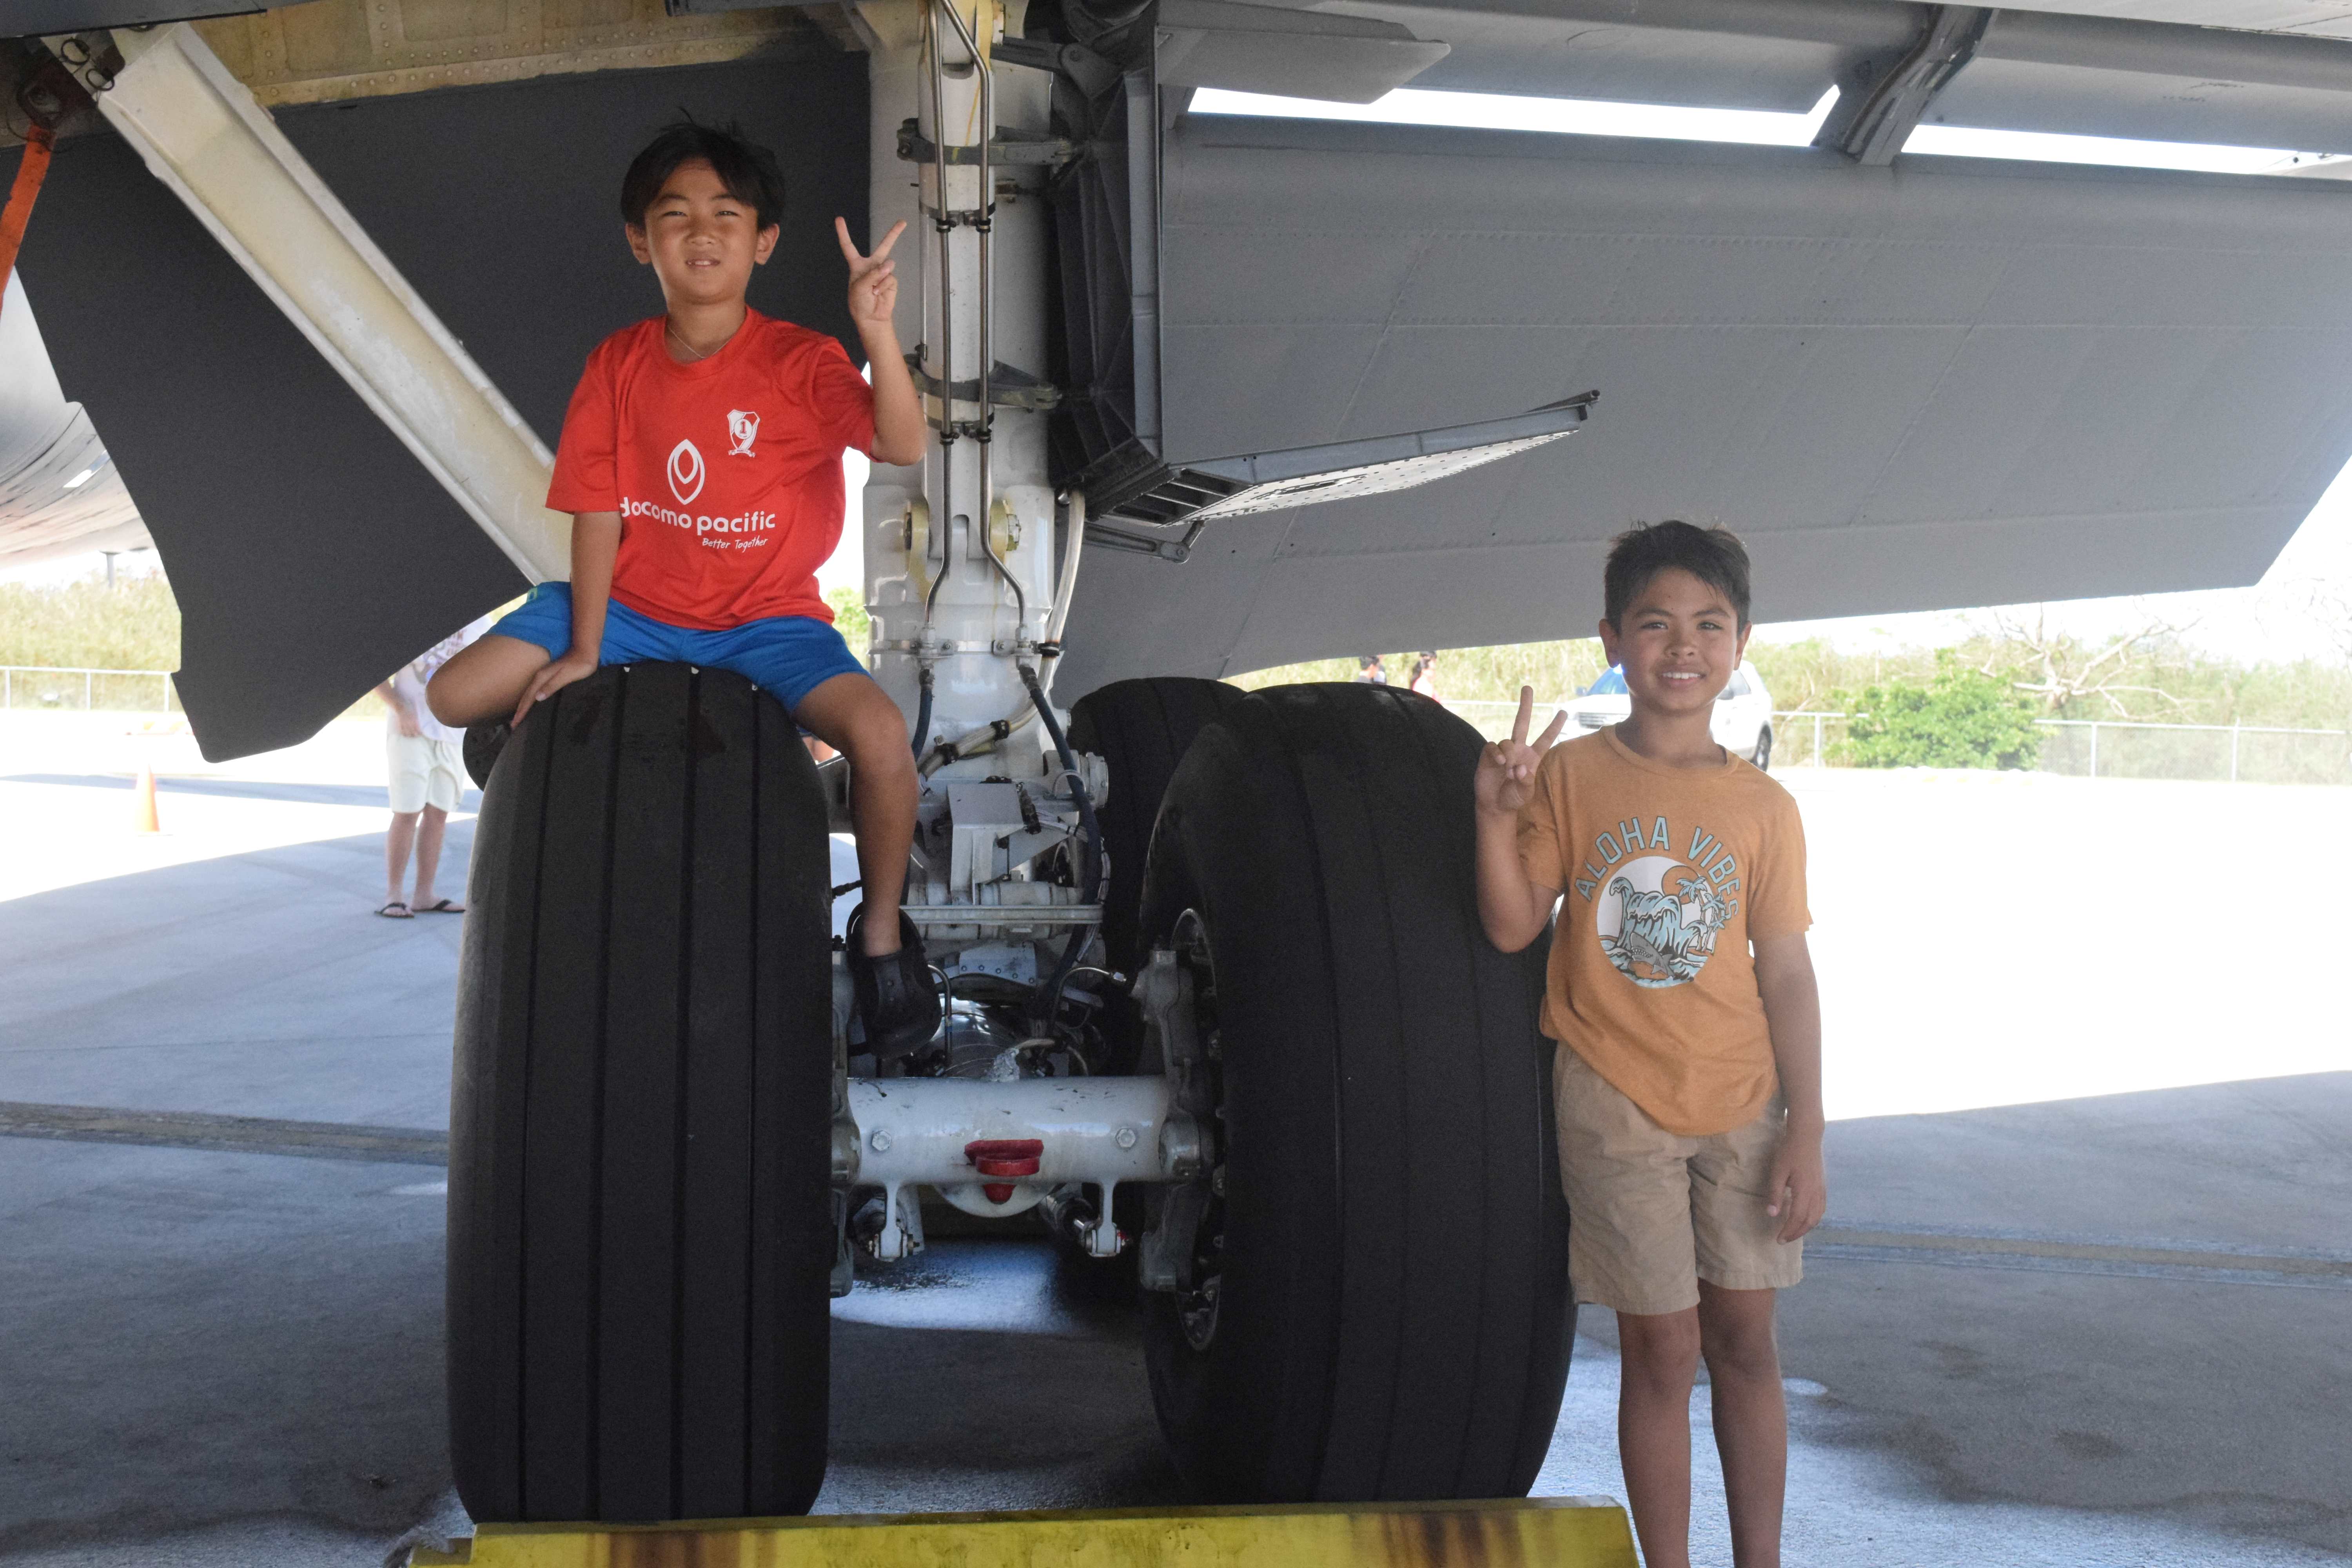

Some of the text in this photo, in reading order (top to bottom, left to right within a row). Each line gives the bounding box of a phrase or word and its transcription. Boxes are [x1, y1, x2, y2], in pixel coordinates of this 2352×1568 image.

[620, 497, 775, 536] docomo pacific
[702, 535, 768, 553] Better Together
[1575, 816, 1740, 920] ALOHA VIBES
